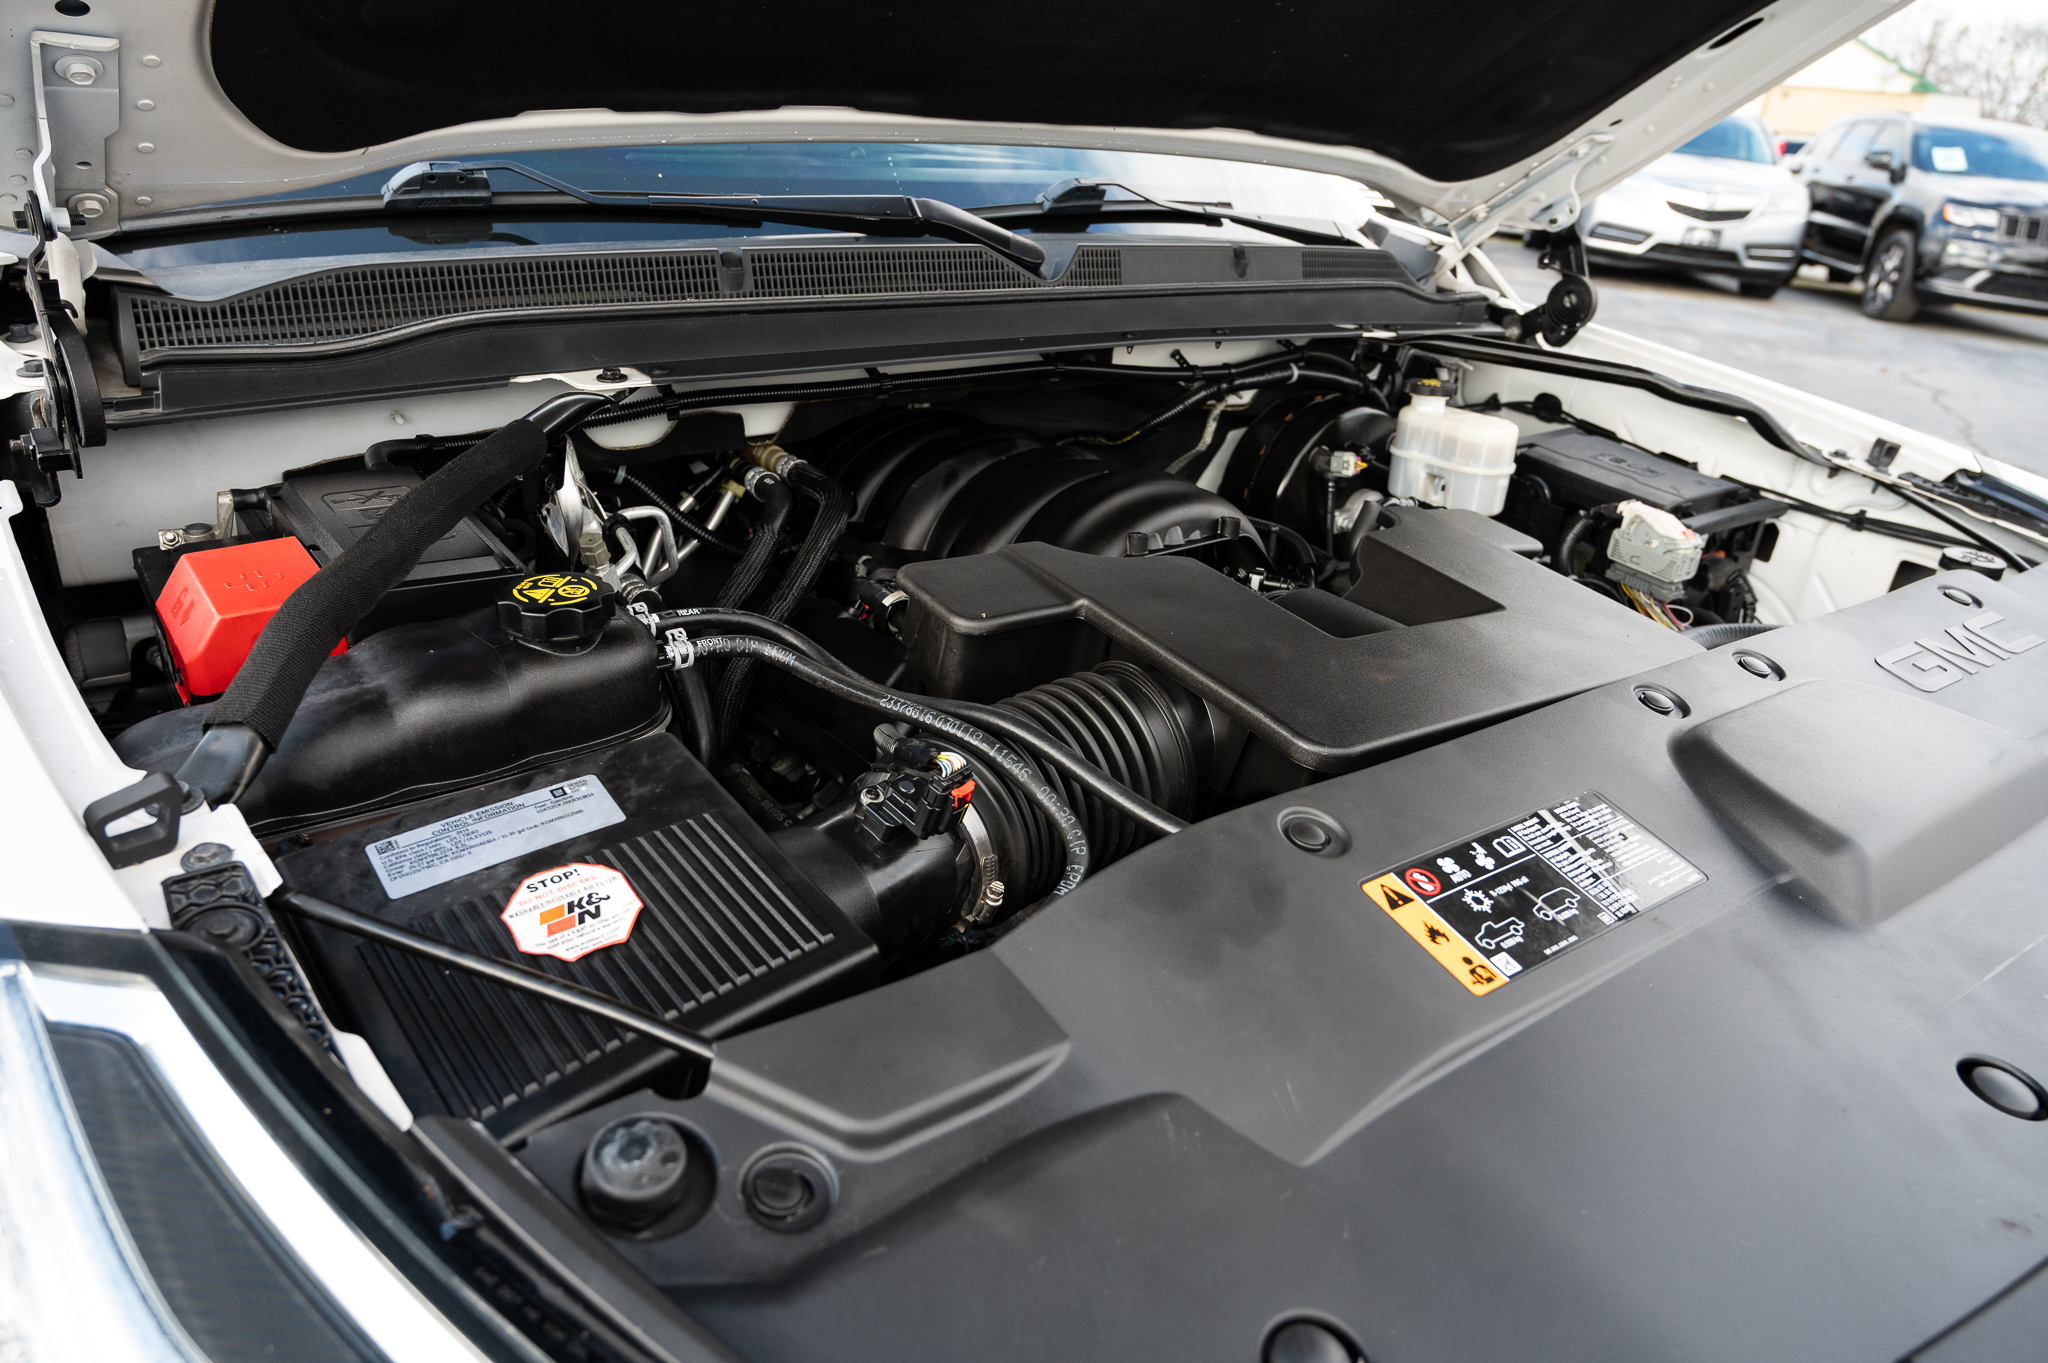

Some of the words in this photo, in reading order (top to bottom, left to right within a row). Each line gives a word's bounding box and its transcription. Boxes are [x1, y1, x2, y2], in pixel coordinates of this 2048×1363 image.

[677, 608, 701, 616] REAR
[697, 637, 723, 648] FRONT
[1874, 611, 2047, 693] GMC
[432, 821, 470, 835] CONTROL
[472, 803, 525, 821] INFORMATION
[440, 814, 474, 827] VEHICLE
[476, 802, 513, 816] EMISSION
[526, 868, 581, 893] STOP!
[1449, 868, 1472, 884] AUTO
[518, 897, 533, 907] DO
[534, 890, 554, 900] NOT
[557, 874, 598, 893] DISCARD
